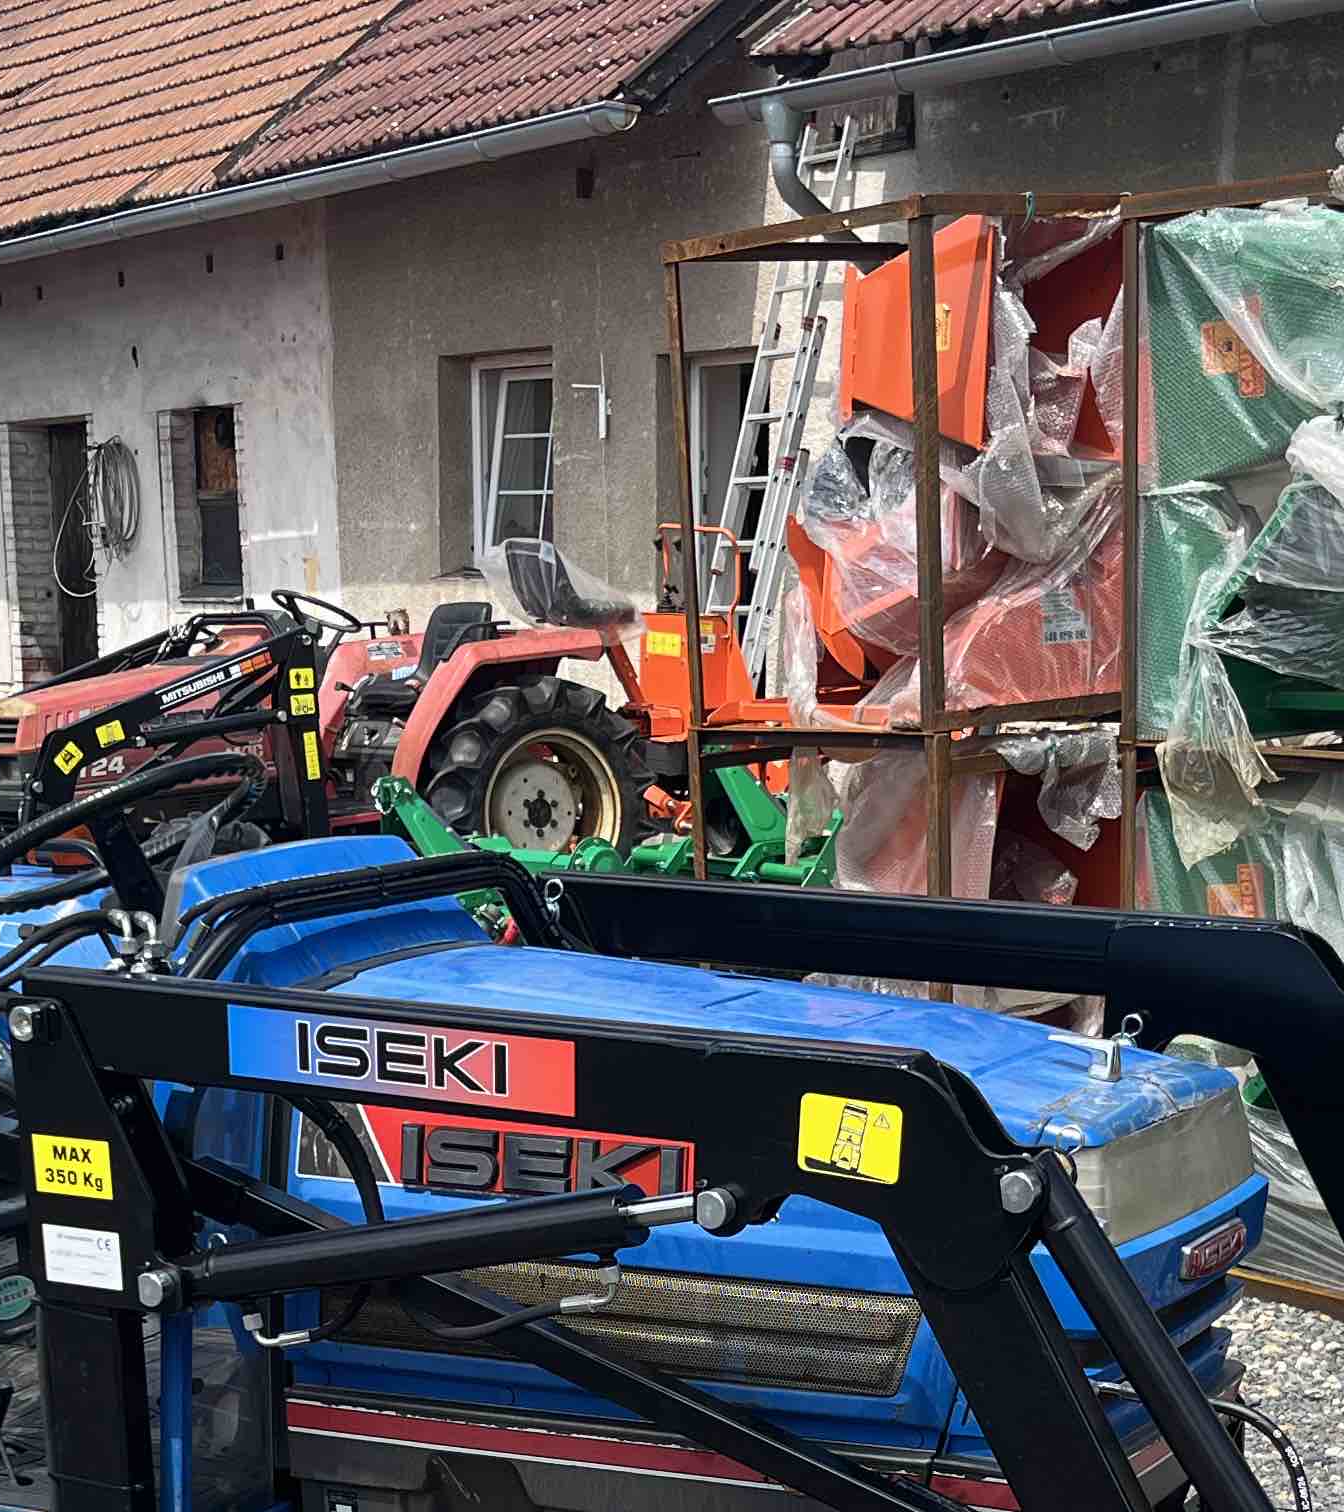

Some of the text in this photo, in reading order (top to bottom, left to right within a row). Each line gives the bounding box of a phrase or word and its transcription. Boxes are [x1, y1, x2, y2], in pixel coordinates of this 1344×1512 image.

[160, 671, 225, 704] MITSUBISHI
[294, 1018, 509, 1098] ISEKI
[52, 1145, 93, 1164] MAX
[400, 1120, 689, 1193] ISEKI
[45, 1167, 103, 1192] 350 Kg
